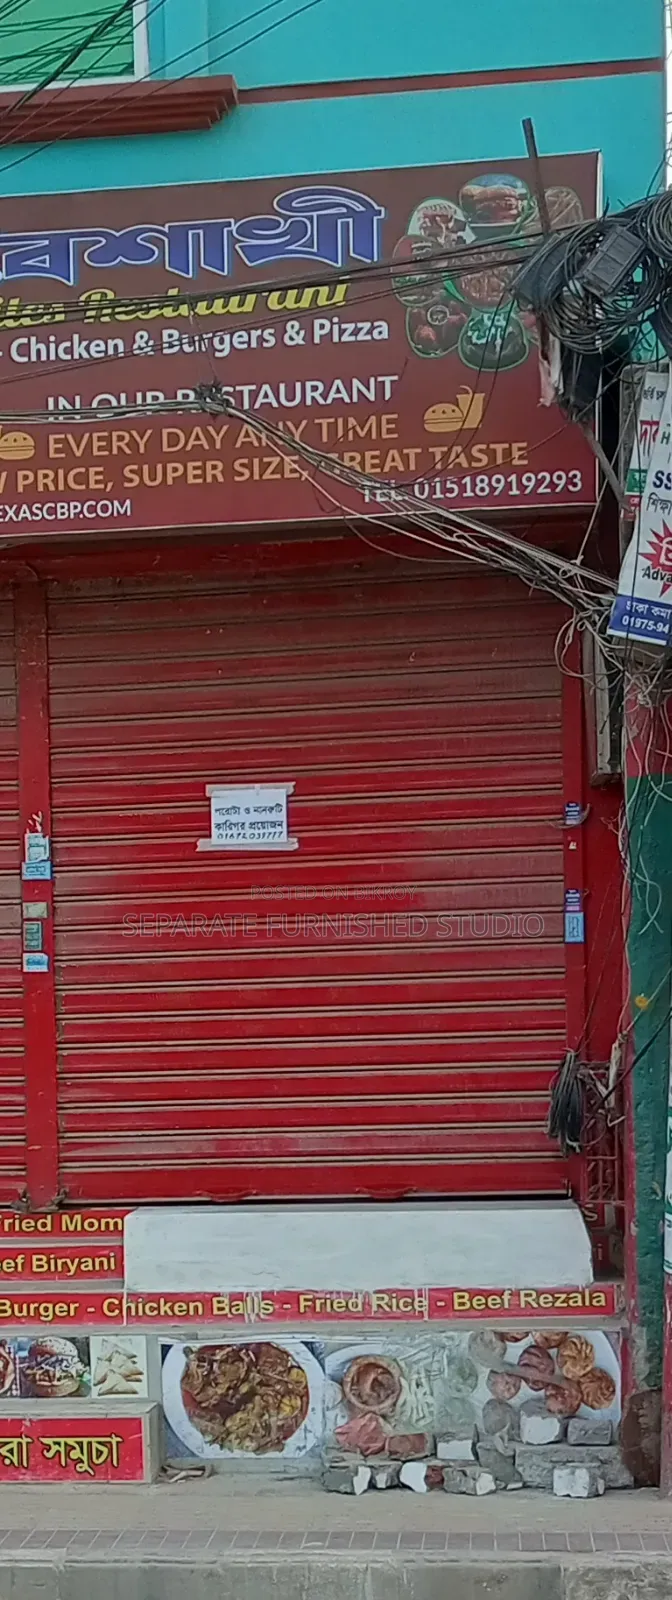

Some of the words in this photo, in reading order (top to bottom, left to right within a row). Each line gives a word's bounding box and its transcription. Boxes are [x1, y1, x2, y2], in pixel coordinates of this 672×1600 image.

[10, 333, 125, 364] Chicken
[132, 330, 155, 356] &
[161, 326, 277, 358] Burgers
[283, 320, 306, 347] &
[312, 316, 390, 345] Pizza
[48, 395, 81, 421] IN
[176, 375, 398, 415] RSTAURANT
[48, 429, 154, 460] EVERY
[161, 424, 230, 453] DAY
[236, 419, 308, 449] ANY
[314, 413, 399, 444] TIME
[17, 465, 114, 494] PRICE,
[123, 458, 224, 488] SUPER
[233, 452, 312, 484] SIZE,
[330, 448, 423, 477] REAT
[428, 442, 529, 469] TASTE
[413, 469, 583, 500] 01518919293
[0, 1214, 52, 1232] ried
[31, 1252, 117, 1276] Biryani
[0, 1299, 79, 1321] Burger
[102, 1297, 203, 1317] Chicken
[299, 1293, 363, 1314] Fried
[453, 1291, 513, 1311] Beef
[519, 1288, 607, 1309] Rezala
[38, 1433, 123, 1476] সমুচা
